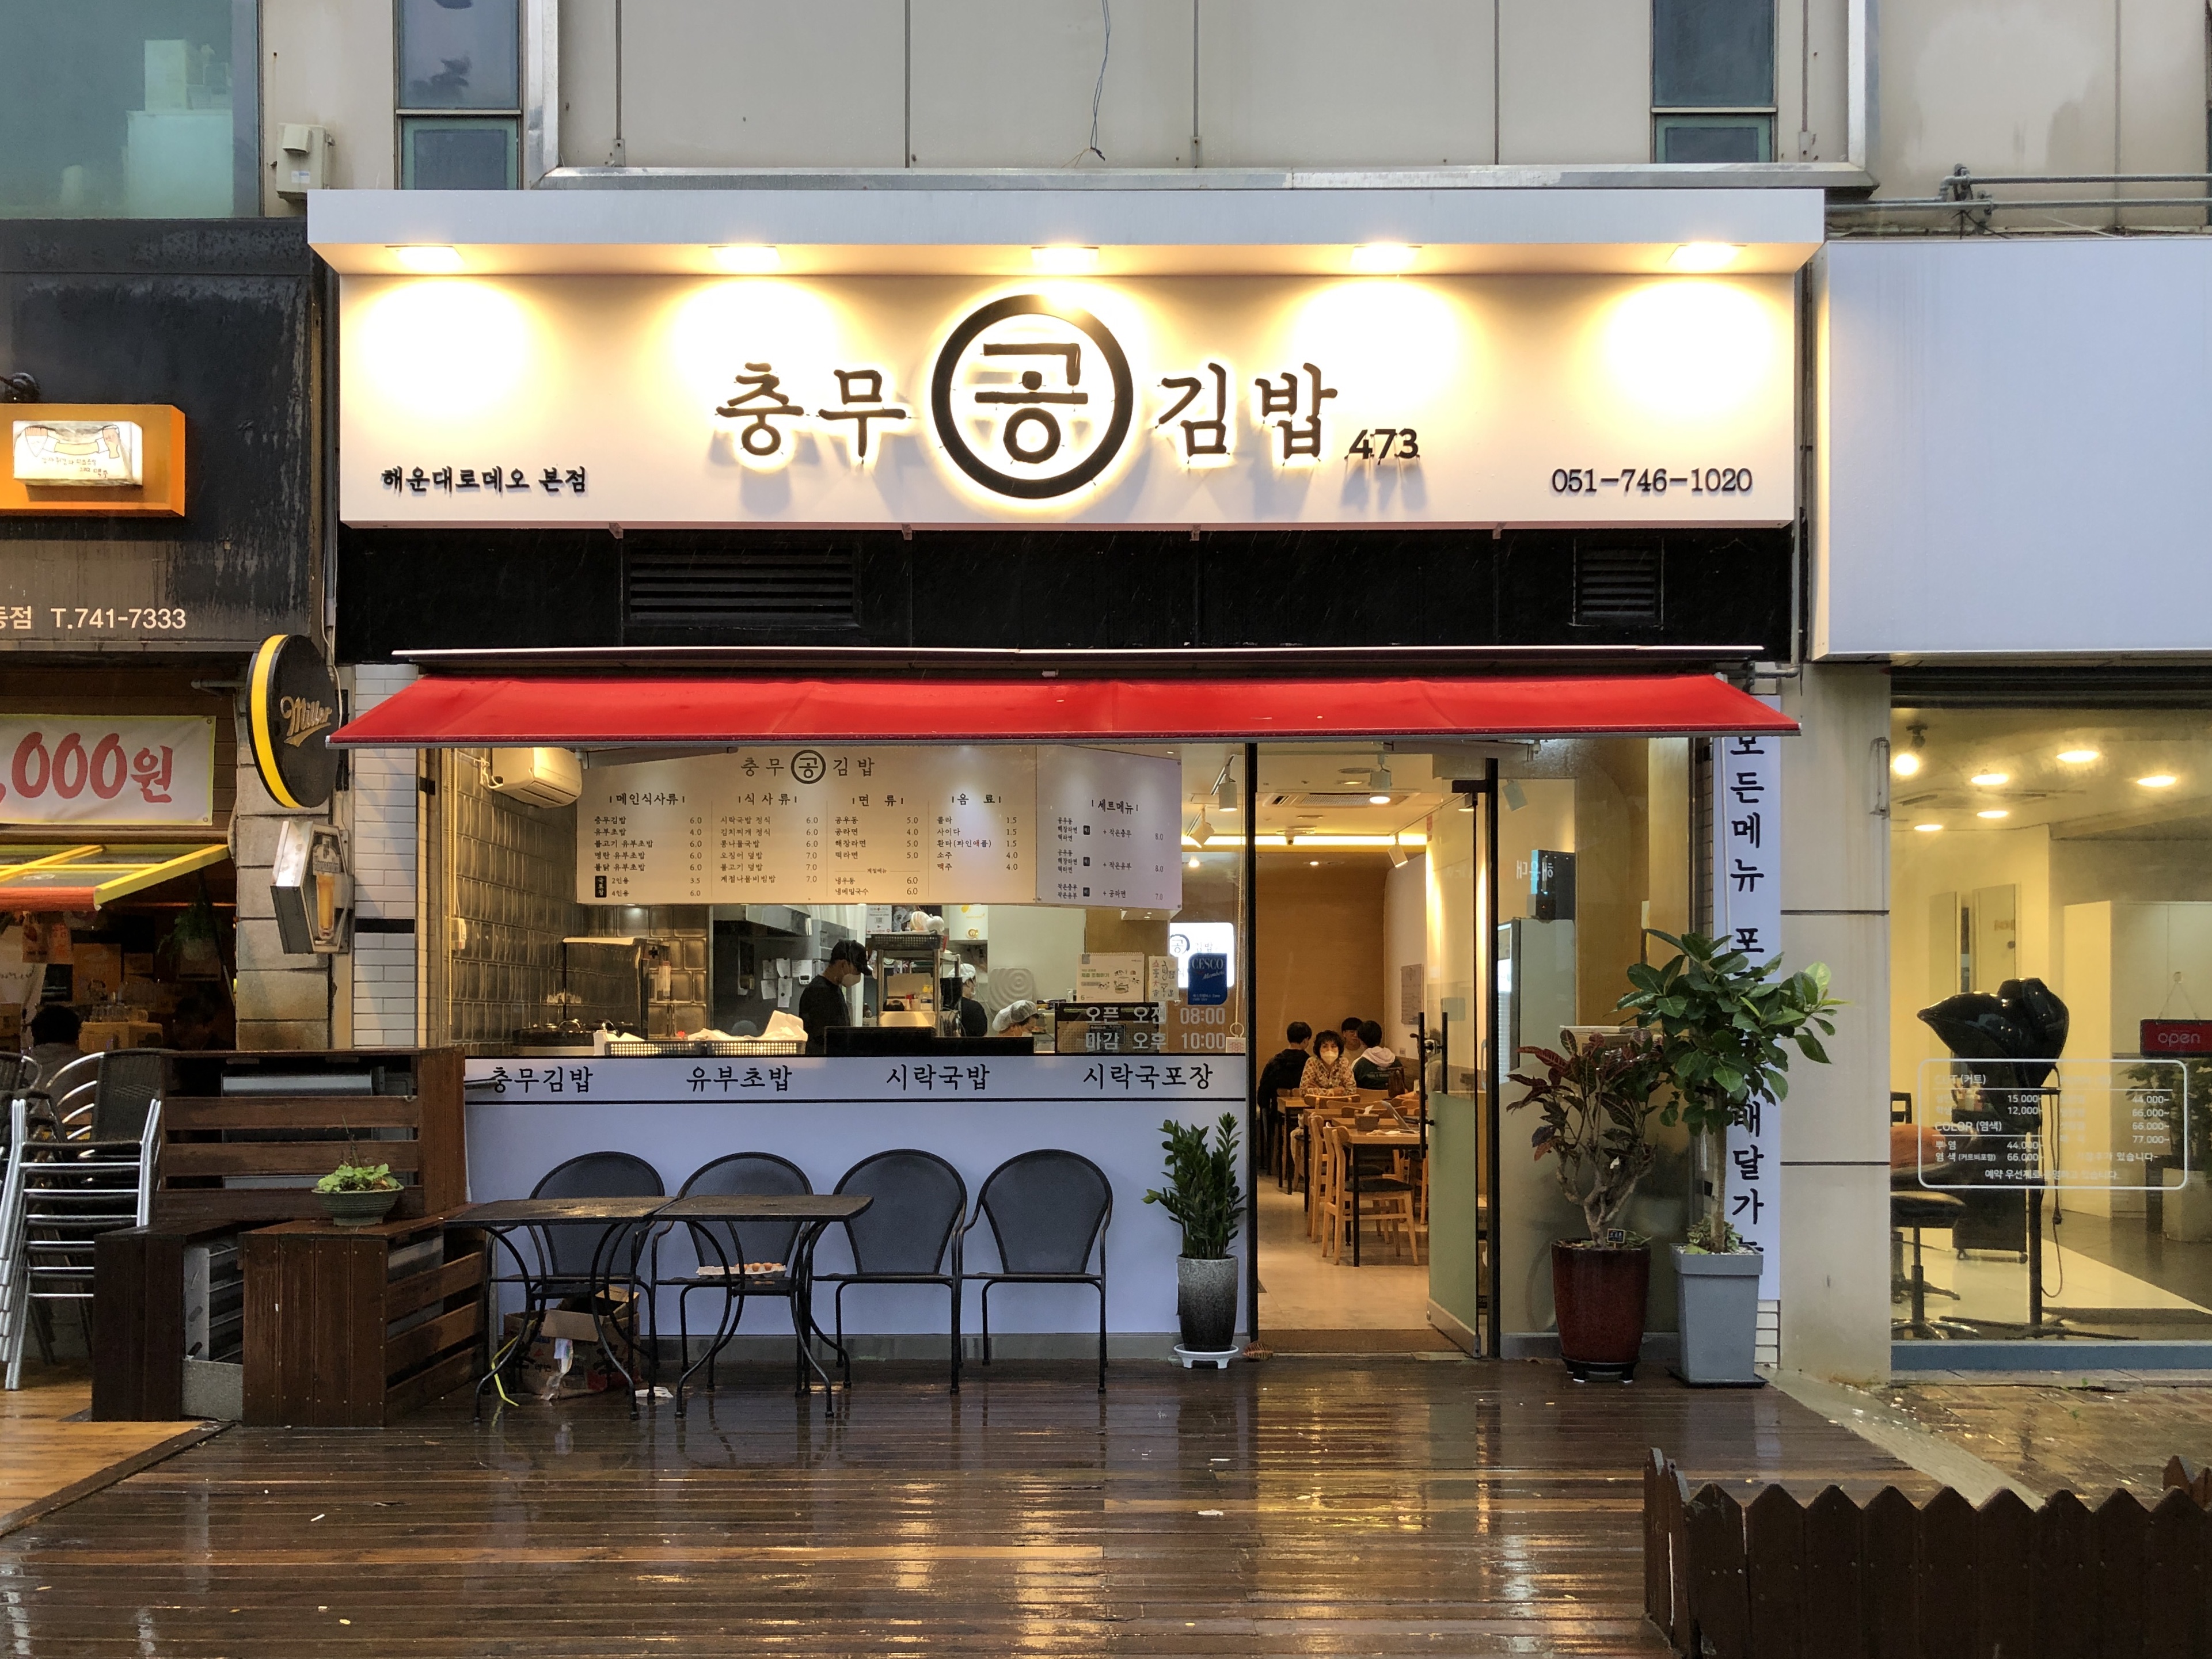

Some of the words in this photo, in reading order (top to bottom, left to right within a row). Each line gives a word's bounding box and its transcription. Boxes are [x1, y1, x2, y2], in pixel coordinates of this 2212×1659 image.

[1346, 428, 1420, 459] 473
[381, 466, 530, 493] 해운대로데오
[538, 466, 586, 494] 본점
[1552, 467, 1753, 493] 051-746-1020
[51, 608, 186, 630] T.741-7333
[280, 696, 333, 737] Miller
[616, 793, 678, 805] 메인식사류
[1098, 798, 1134, 815] 세트메뉴
[594, 816, 626, 824] 충무김밥
[756, 816, 770, 824] 정식
[937, 816, 952, 824] 콜라
[594, 828, 626, 836] 유부초밥
[720, 828, 751, 836] 김치찌개
[756, 828, 770, 836] 정식
[835, 828, 858, 836] 공라면
[937, 828, 960, 836] 사이다
[594, 840, 618, 848] 불고기
[622, 840, 653, 848] 유부초밥
[720, 840, 760, 848] 콩나물국밥
[835, 839, 866, 848] 해장라면
[594, 851, 609, 859] 명란
[613, 851, 645, 859] 유부초밥
[720, 851, 743, 859] 오징어
[748, 851, 763, 859] 덮밥
[835, 851, 858, 859] 떡라면
[594, 863, 609, 872] 불닭
[613, 863, 645, 872] 유부초밥
[937, 863, 952, 871] 맥주
[720, 875, 776, 883] 계절나물비빔밥
[835, 877, 856, 885] 냉우동
[835, 888, 869, 896] 냉메밀국수
[1730, 928, 1764, 982] 포
[1191, 958, 1223, 971] CESCO
[1086, 1006, 1119, 1025] 오픈
[1133, 1006, 1167, 1025] 오전
[1180, 1007, 1225, 1025] 08:00
[1086, 1032, 1119, 1050] 마감
[1132, 1032, 1167, 1050] 오후
[1182, 1033, 1225, 1049] 10:00
[2157, 1033, 2200, 1048] open
[491, 1066, 594, 1093] 충무김밥
[686, 1064, 793, 1093] 유부초밥
[886, 1064, 990, 1091] 시락국밥
[1084, 1063, 1213, 1090] 시락국포장
[1960, 1074, 1986, 1085] (커트)
[1934, 1121, 1973, 1132] COLOR
[1976, 1121, 2002, 1132] (염색)
[1732, 1101, 1764, 1252] 배달가
[1985, 1169, 2003, 1179] 예약
